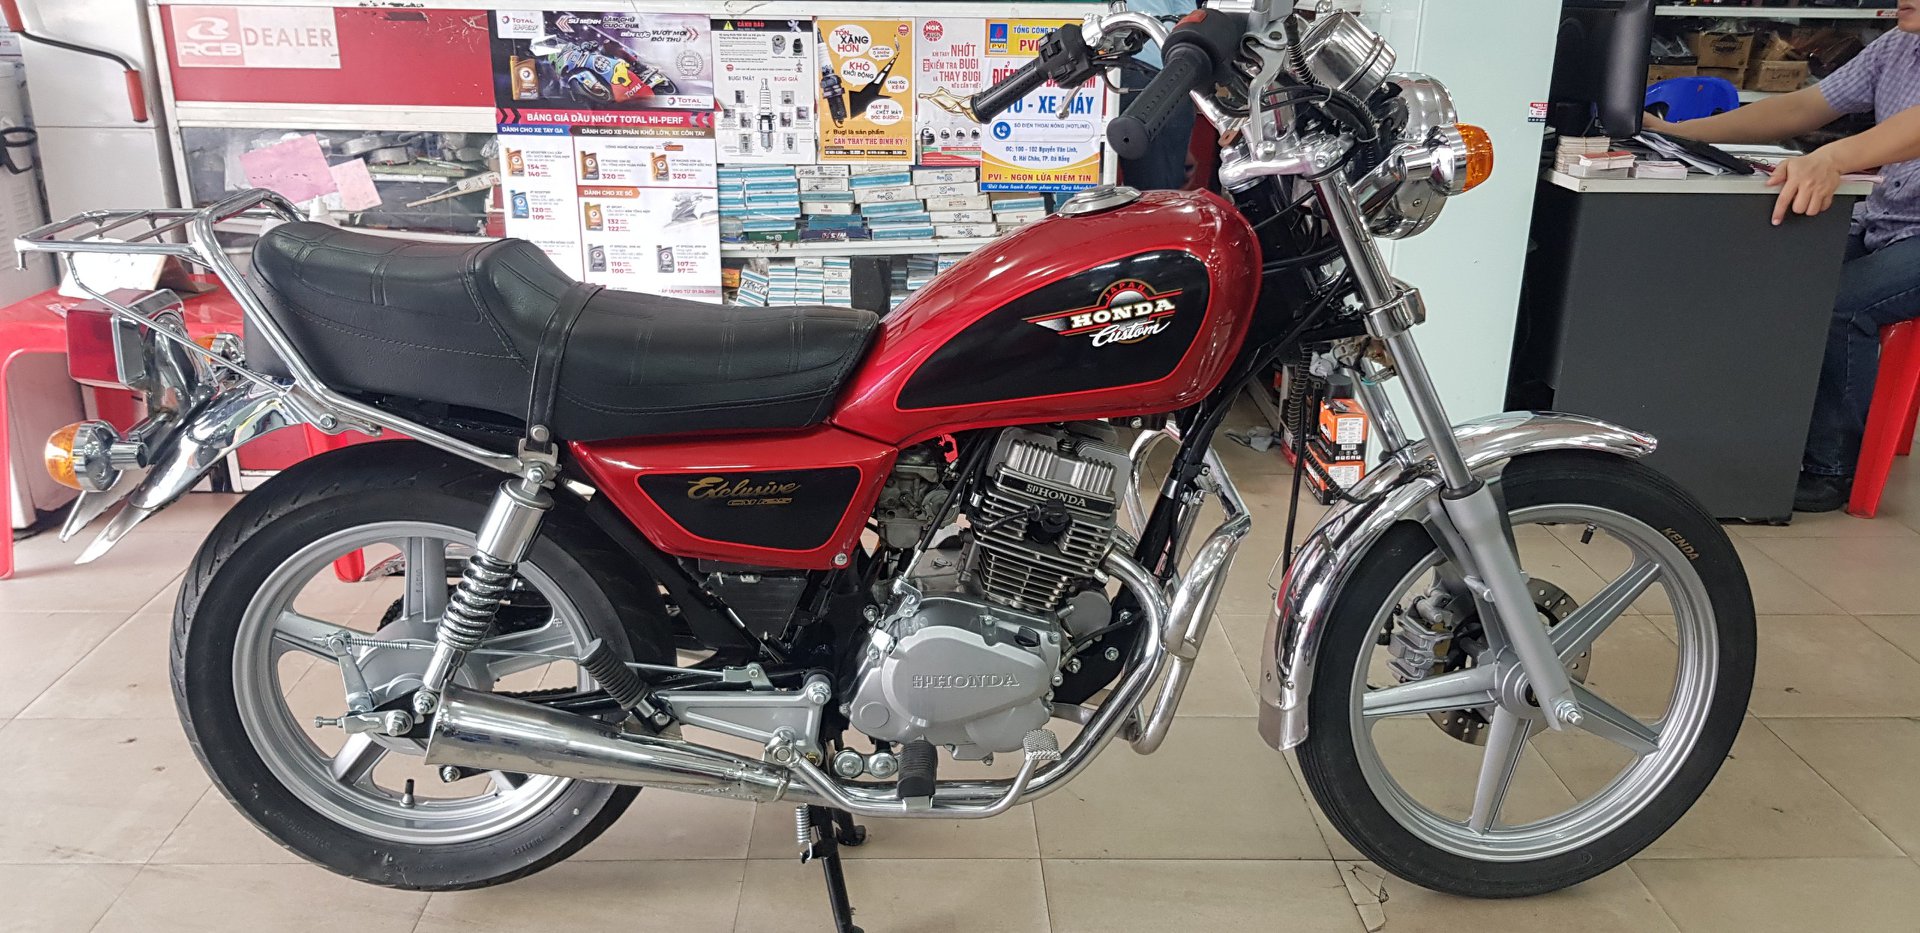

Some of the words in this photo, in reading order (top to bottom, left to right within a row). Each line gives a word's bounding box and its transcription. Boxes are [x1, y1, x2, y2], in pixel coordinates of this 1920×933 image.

[244, 27, 333, 47] DEALER
[841, 34, 868, 44] XĂNG
[181, 44, 242, 56] RCB
[838, 44, 859, 52] HƠN
[951, 42, 976, 56] NHỚT
[1020, 40, 1039, 51] PVI
[850, 62, 870, 71] KHÓ
[930, 59, 944, 69] KIỂM
[960, 59, 978, 69] BUGI
[940, 71, 960, 81] THAY
[963, 71, 981, 81] BUGI
[992, 61, 1020, 87] ĐIỂ
[625, 84, 642, 98] TOTAL
[1038, 96, 1056, 113] XE
[527, 112, 552, 121] BẢNG
[554, 113, 571, 122] GIÁ
[571, 113, 590, 123] DẦU
[592, 113, 619, 123] NHỚT
[1011, 174, 1033, 182] NGỌN
[1036, 172, 1051, 181] LỬA
[1105, 281, 1146, 300] JAPAN
[1071, 299, 1175, 329] HONDA
[1090, 320, 1170, 347] Custom
[688, 477, 801, 499] Exclusive
[1662, 528, 1699, 560] KENDA
